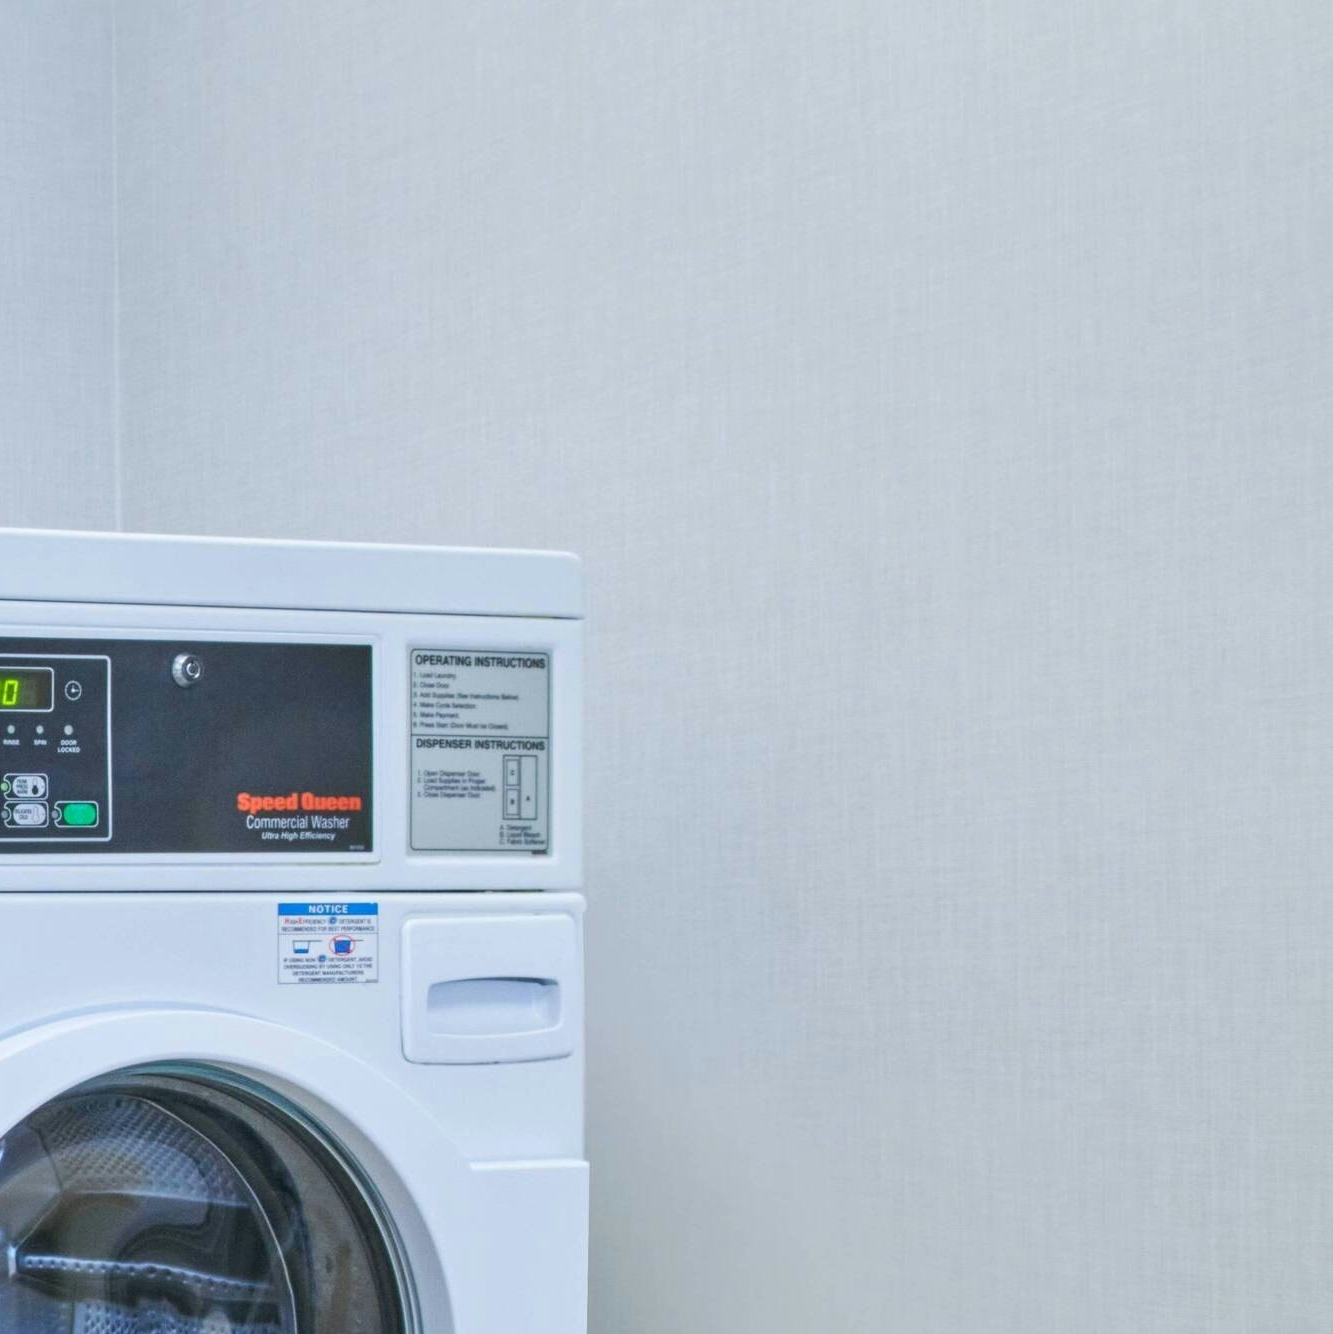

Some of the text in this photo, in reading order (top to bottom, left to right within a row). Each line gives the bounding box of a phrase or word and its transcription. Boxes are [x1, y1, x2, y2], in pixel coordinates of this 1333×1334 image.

[415, 654, 546, 669] OPERATING INSTRUCTIONS
[416, 739, 545, 751] DISPENSER INSTRUCTIONS
[237, 792, 361, 814] Speed Queen
[246, 814, 350, 830] Commercial Washer
[261, 831, 336, 841] Ultra High Efficiency
[309, 905, 349, 913] NOTICE
